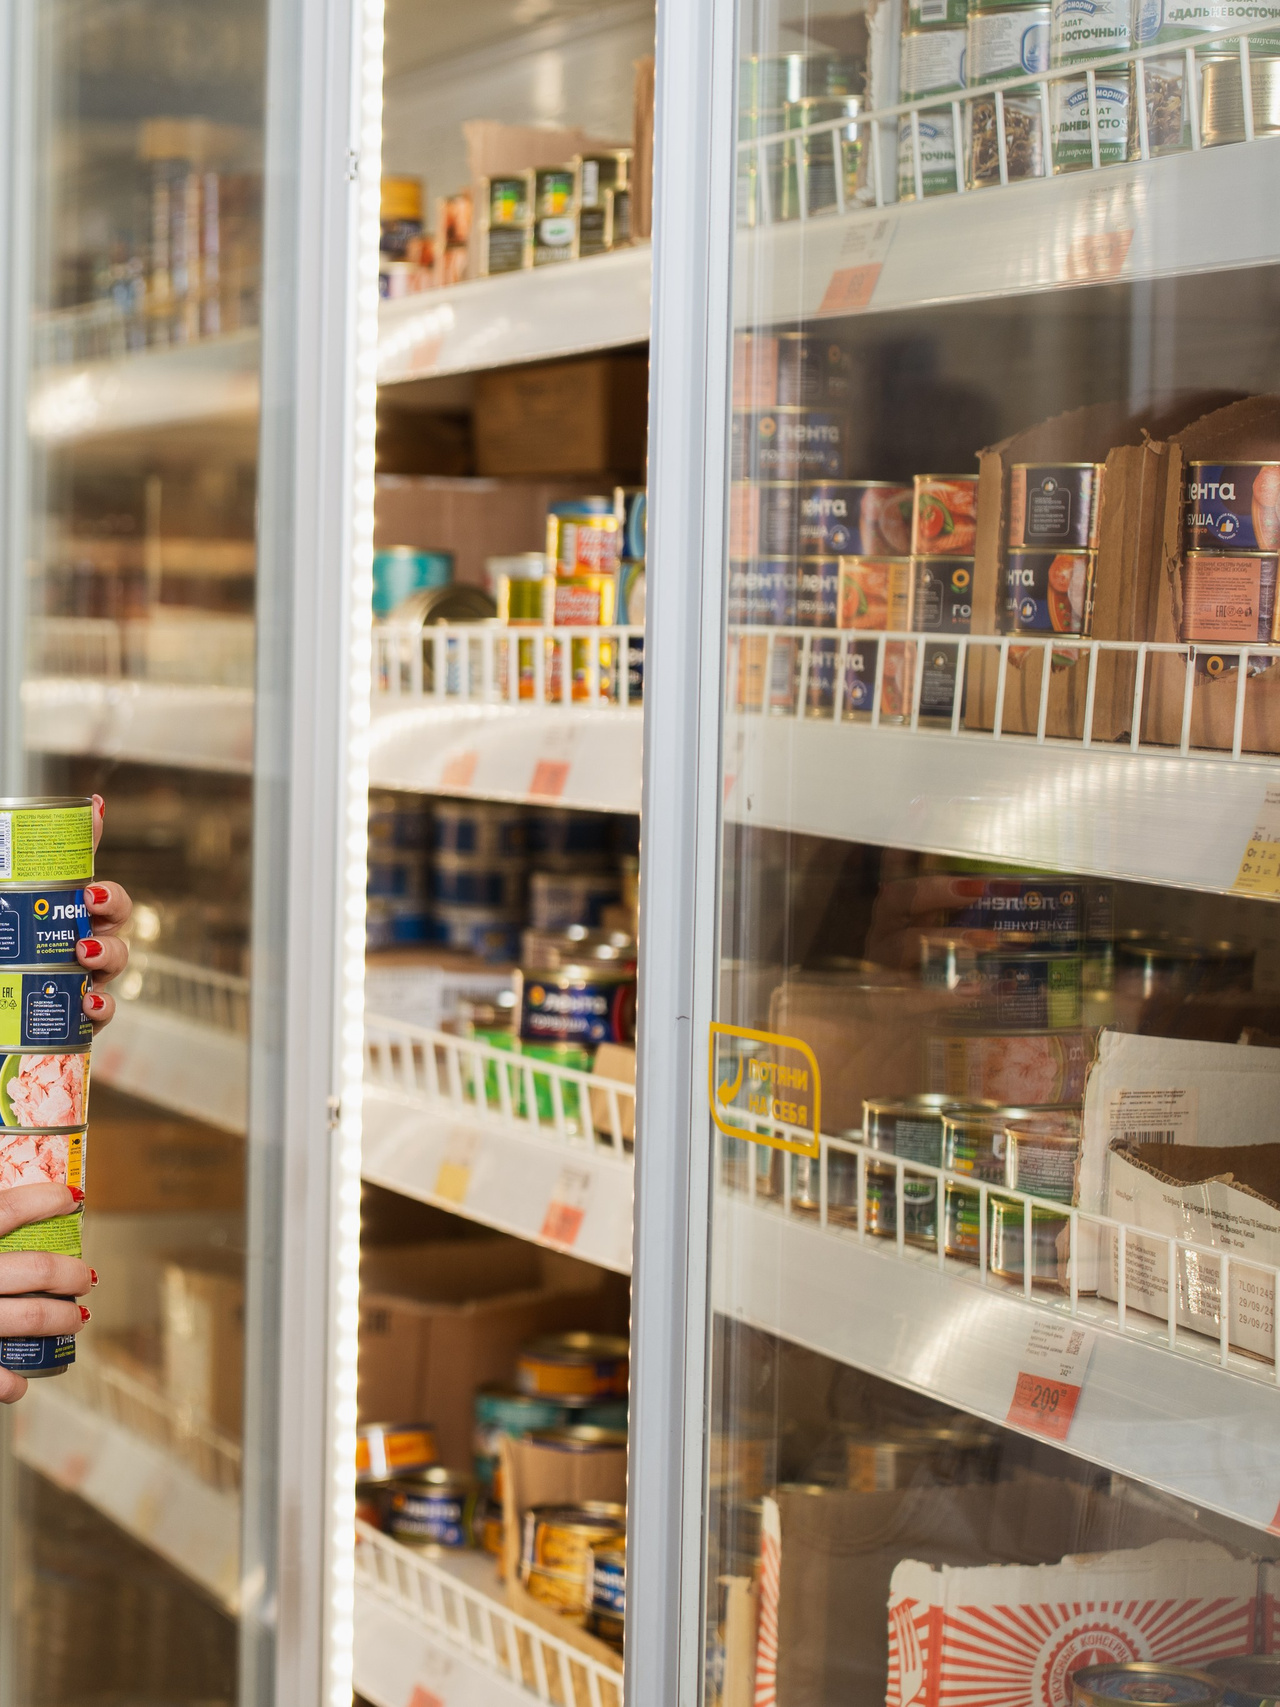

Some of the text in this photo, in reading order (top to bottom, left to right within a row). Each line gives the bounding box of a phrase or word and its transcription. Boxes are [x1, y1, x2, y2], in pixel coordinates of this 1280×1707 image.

[1247, 848, 1257, 858] От
[1242, 863, 1252, 873] От
[36, 930, 75, 941] ТУНЕЦ
[748, 1058, 808, 1092] ПОТЯНИ
[748, 1093, 808, 1126] НА СЕБЯ
[56, 1335, 75, 1346] ТУНЕ
[1031, 1385, 1060, 1413] 209
[1052, 1643, 1078, 1702] ВКУСНЫЕ
